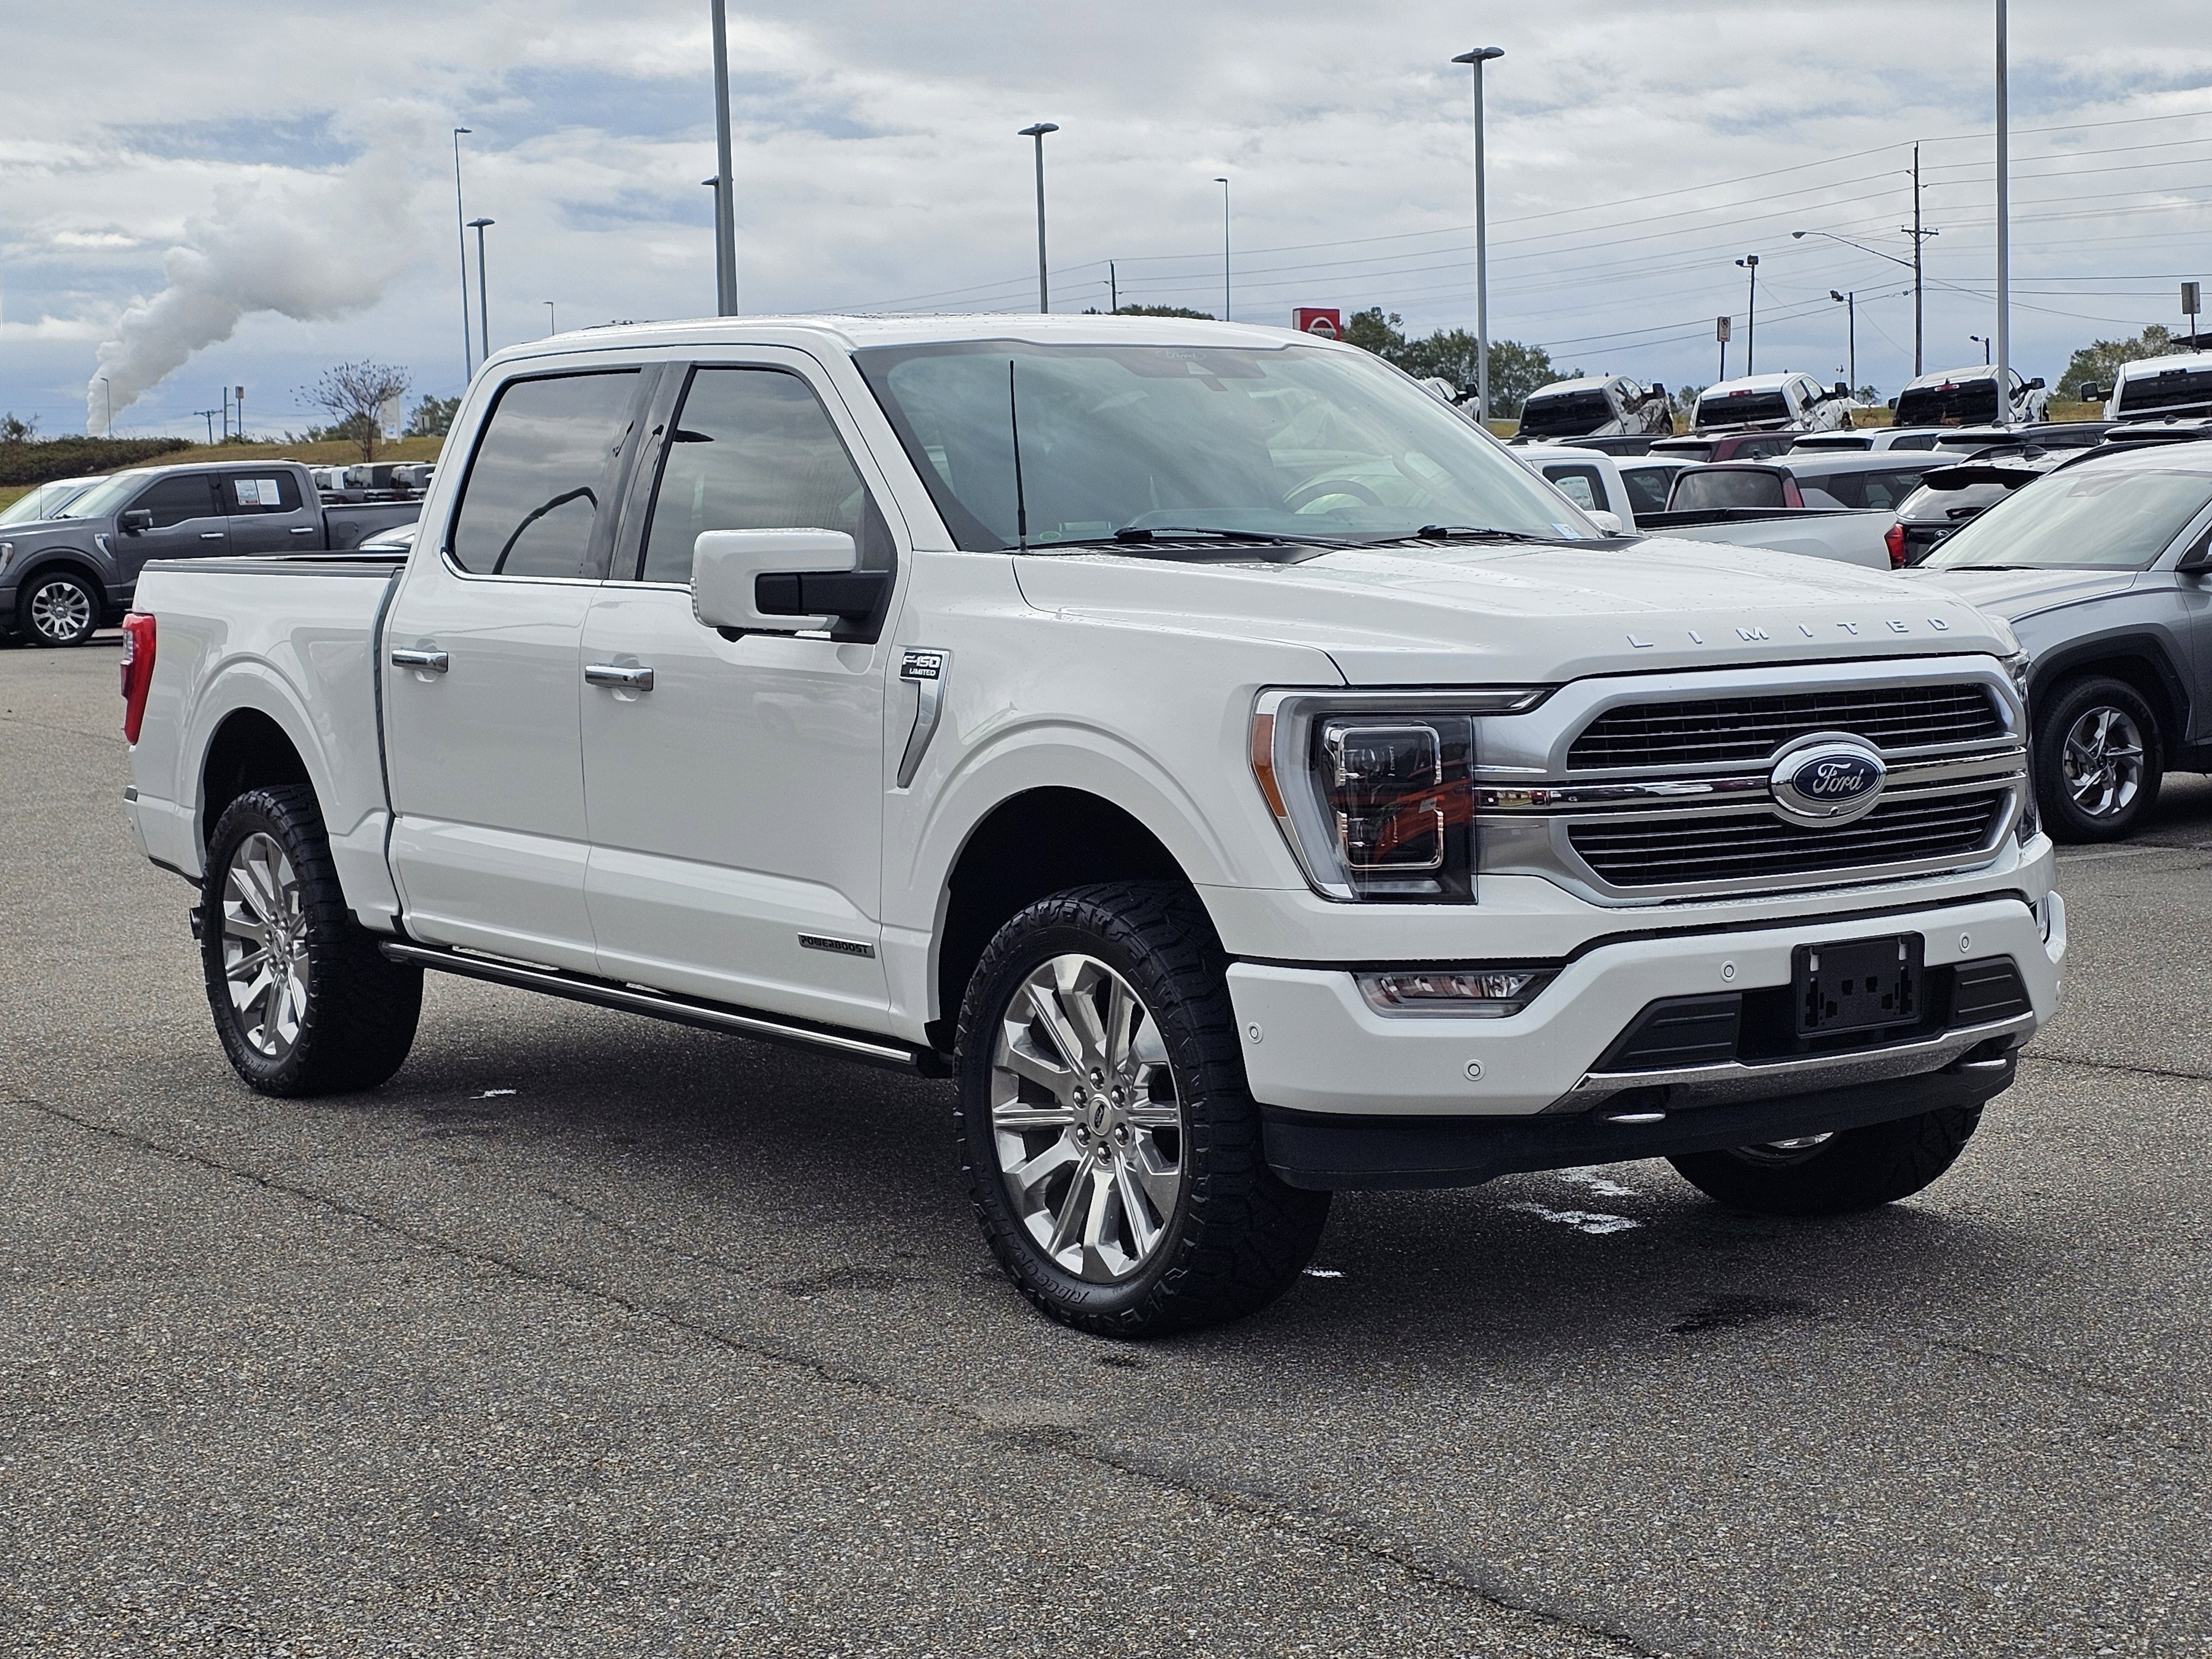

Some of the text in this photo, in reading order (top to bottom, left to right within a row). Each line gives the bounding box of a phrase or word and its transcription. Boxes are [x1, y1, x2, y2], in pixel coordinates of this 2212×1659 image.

[1627, 618, 1949, 648] LIMITED
[902, 655, 941, 668] F-150
[909, 667, 936, 676] LIMITED
[1812, 763, 1864, 794] Ford
[801, 935, 867, 954] POWERBOOST
